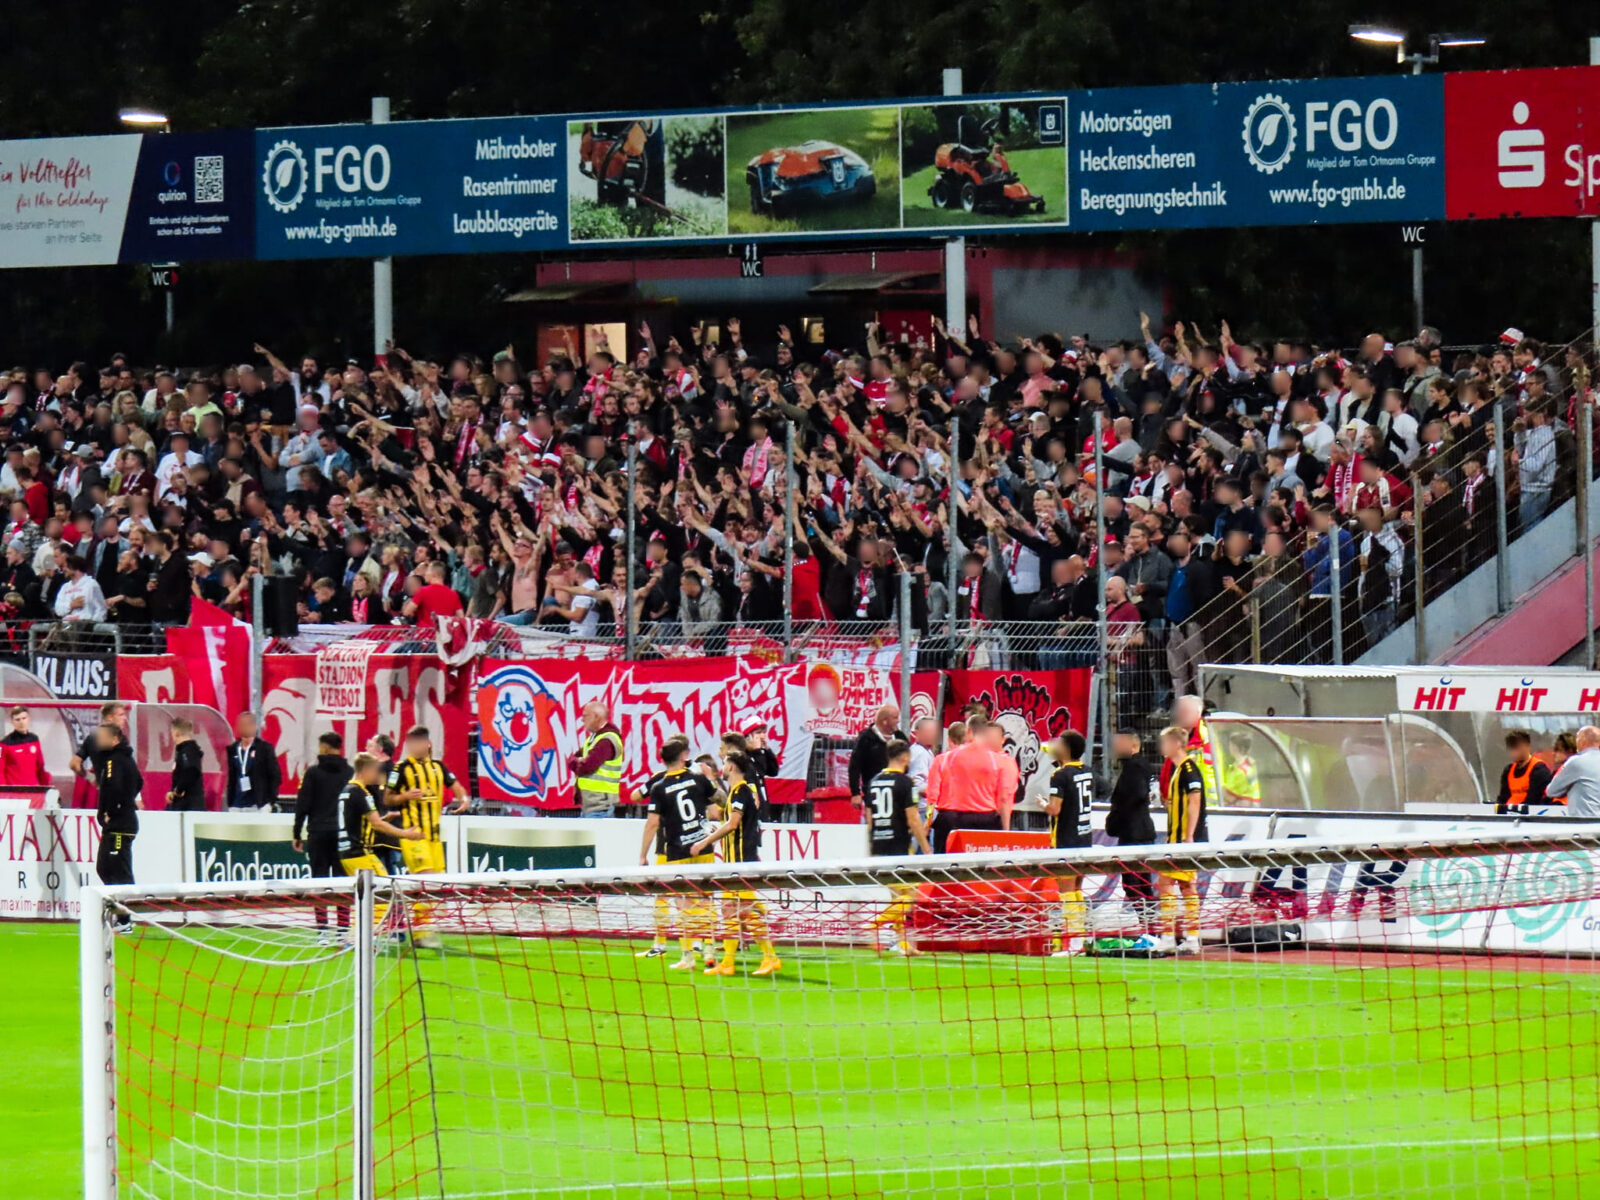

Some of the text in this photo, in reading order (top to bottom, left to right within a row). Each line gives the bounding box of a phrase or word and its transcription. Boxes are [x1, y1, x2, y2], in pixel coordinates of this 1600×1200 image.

[1079, 109, 1172, 137] Motorsägen
[1306, 98, 1398, 151] FGO
[475, 135, 557, 160] Mähroboter
[1080, 144, 1196, 172] Heckenscheren
[20, 157, 91, 189] Volltreffer
[315, 144, 391, 192] FGO
[1306, 153, 1436, 171] Mitglied der Tom Ortmanns Gruppe
[158, 189, 187, 204] quirion
[463, 173, 558, 196] Rasentrimmer
[1081, 181, 1227, 215] Beregnungstechnik
[1269, 177, 1406, 208] www.fgo-gmbh.de
[285, 215, 397, 243] www.fgo-gmbh.de
[453, 209, 558, 237] Laubblasgeräte
[1402, 226, 1425, 243] WC
[152, 271, 170, 286] WC
[742, 260, 761, 276] WC
[36, 656, 110, 697] KLAUS:
[319, 665, 366, 685] STADION
[320, 687, 361, 707] VERBOT
[676, 789, 696, 821] 6
[870, 786, 893, 819] 30
[1076, 780, 1092, 814] 15
[200, 847, 312, 882] Kaloderma
